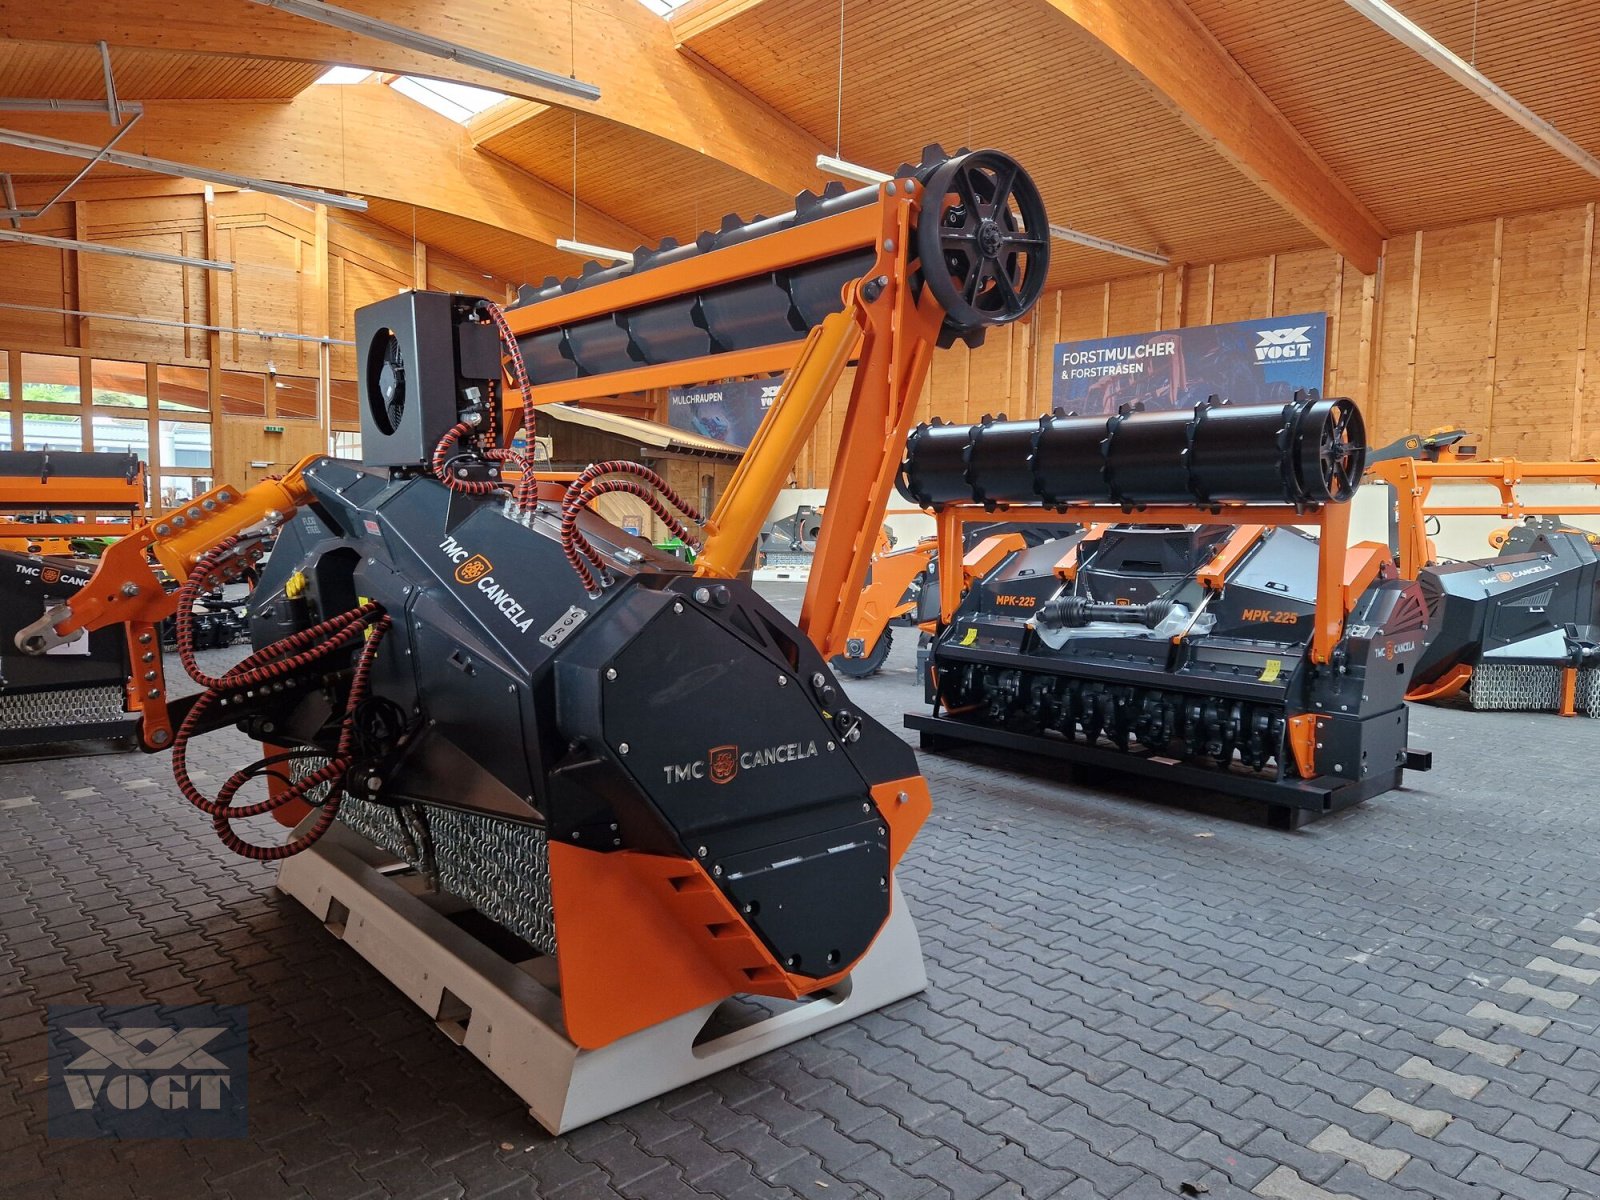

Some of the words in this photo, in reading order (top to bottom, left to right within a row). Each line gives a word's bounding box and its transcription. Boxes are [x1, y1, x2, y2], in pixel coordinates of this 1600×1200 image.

[1063, 342, 1175, 366] FORSTMULCHER
[1255, 343, 1311, 360] VOGT
[1061, 371, 1069, 380] &
[1071, 363, 1144, 379] FORSTFRÄSEN
[672, 392, 723, 406] MULCHRAUPEN
[15, 564, 41, 577] TMC
[60, 574, 91, 587] CANC
[1512, 564, 1552, 578] CANCELA
[438, 536, 470, 564] TMC
[477, 577, 537, 633] CANCELA
[996, 595, 1036, 607] MPK-225
[1242, 609, 1298, 624] MPK-225
[664, 760, 704, 784] TMC
[740, 740, 818, 770] CANCELA
